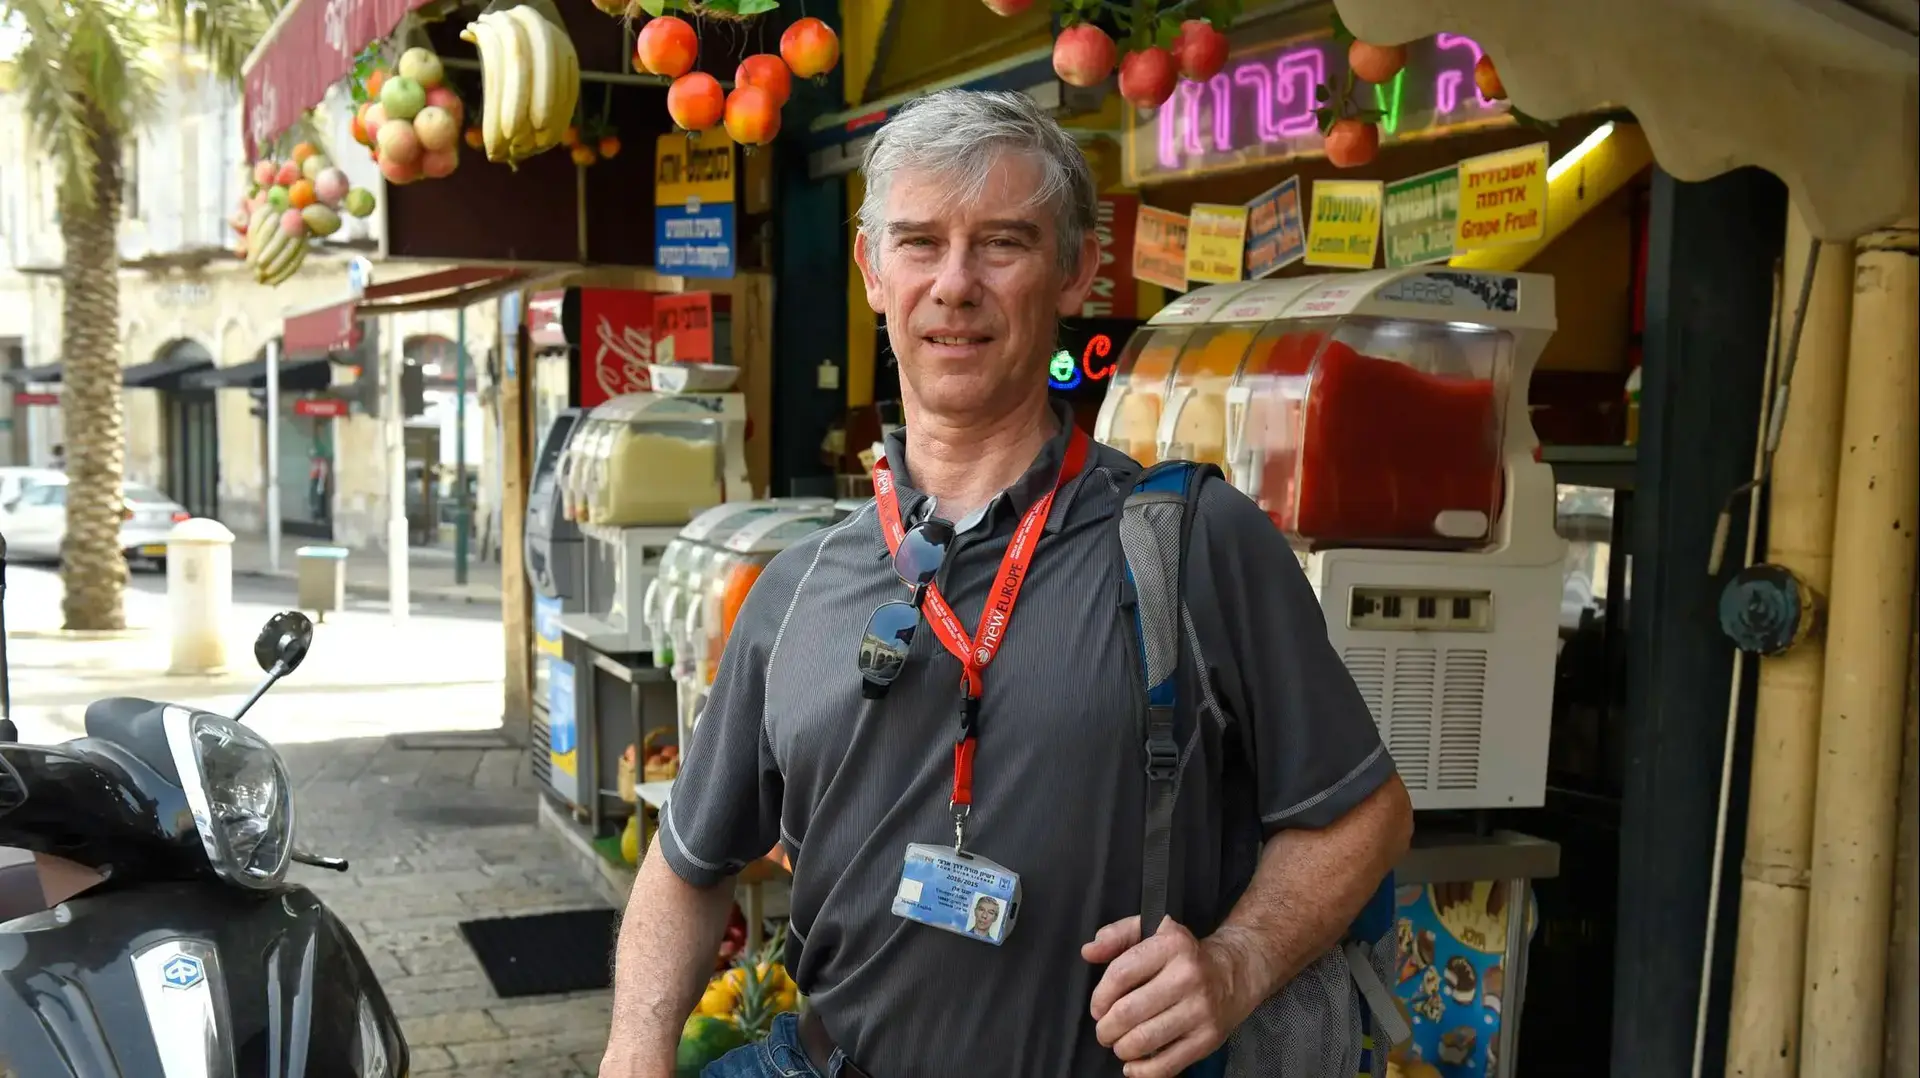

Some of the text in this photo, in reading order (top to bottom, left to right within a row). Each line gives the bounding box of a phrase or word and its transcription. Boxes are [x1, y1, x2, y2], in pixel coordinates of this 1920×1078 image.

[1476, 186, 1526, 209] אדומה
[1461, 209, 1538, 240] Grape Fruit
